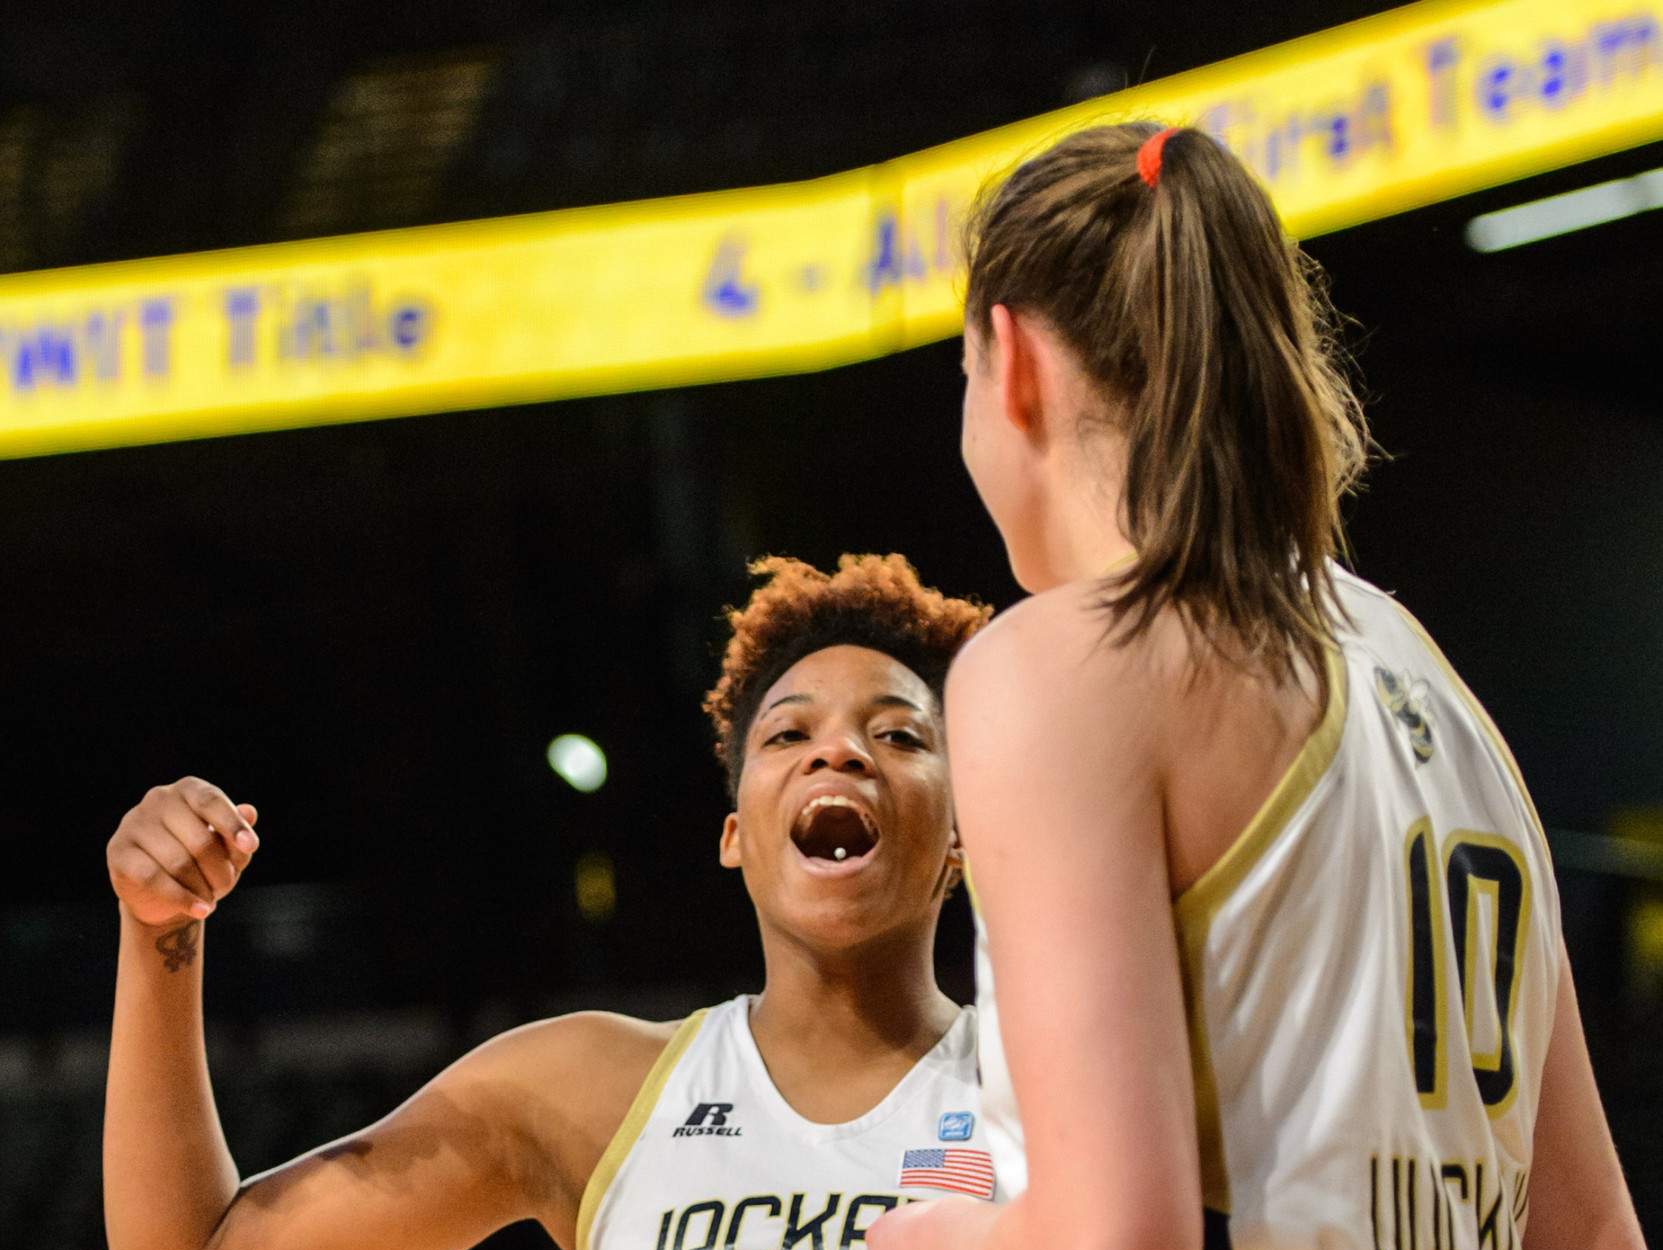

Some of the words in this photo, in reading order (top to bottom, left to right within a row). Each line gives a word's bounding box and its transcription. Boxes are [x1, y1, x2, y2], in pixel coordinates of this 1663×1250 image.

[1420, 18, 1663, 132] Team
[1404, 815, 1532, 1119] 10
[672, 1126, 743, 1138] RUSSELL
